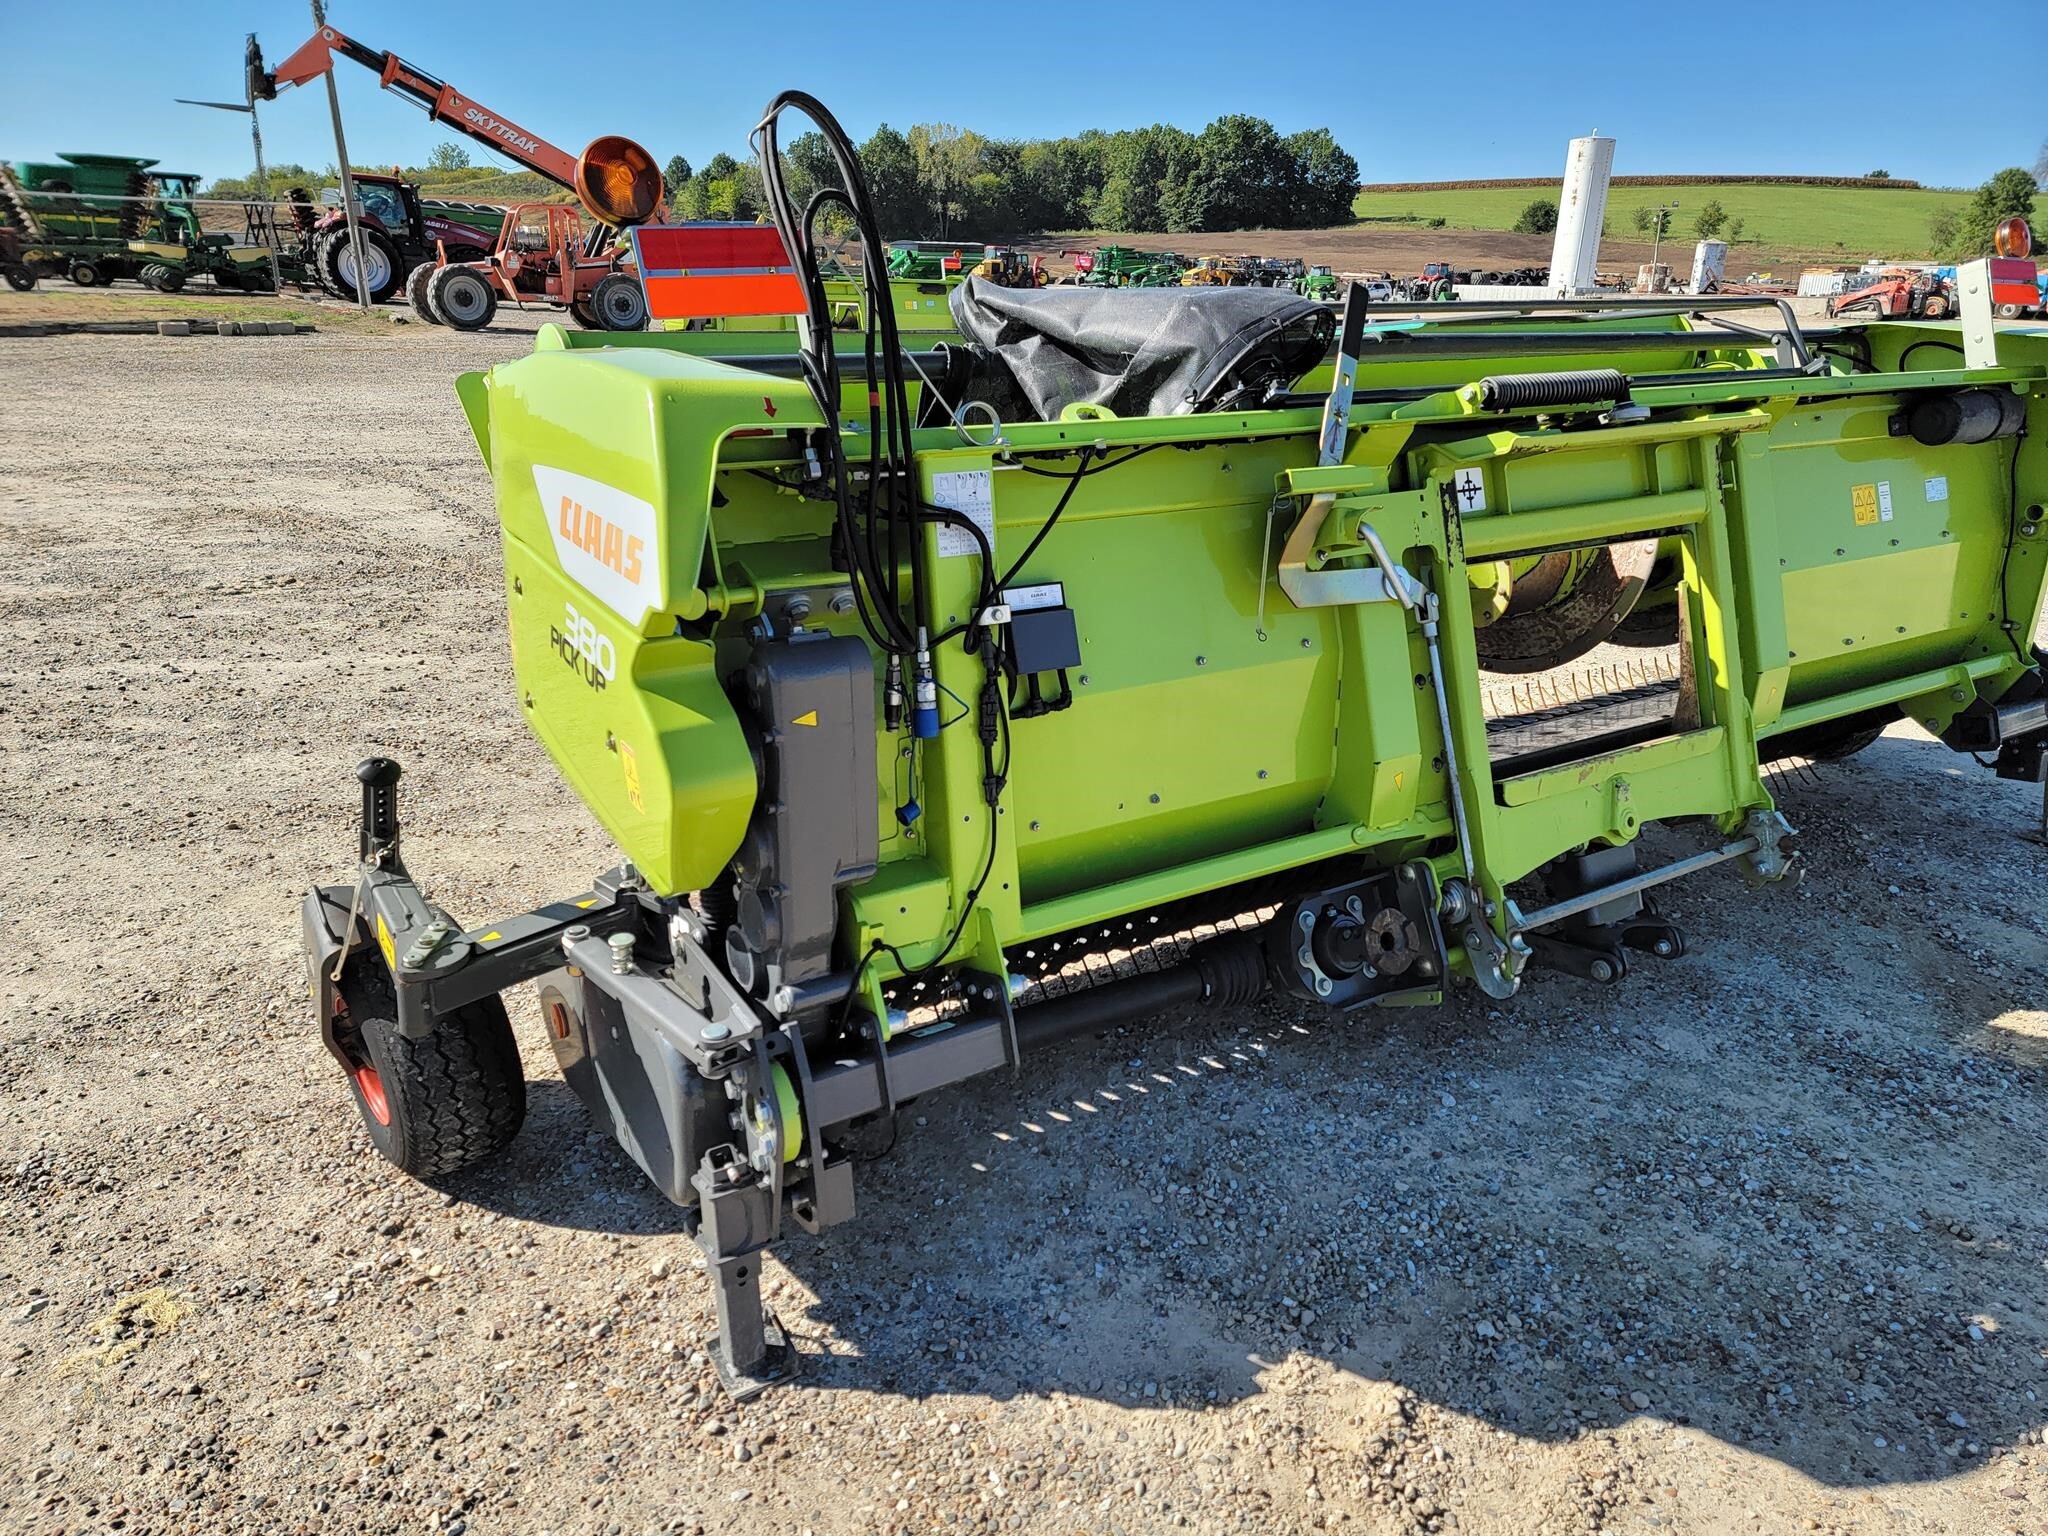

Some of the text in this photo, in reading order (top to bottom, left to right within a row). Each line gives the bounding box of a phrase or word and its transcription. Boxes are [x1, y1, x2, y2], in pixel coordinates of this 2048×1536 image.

[463, 107, 540, 155] SKYTRAK
[559, 495, 645, 586] CLAAS
[550, 623, 607, 694] PICK UP
[564, 600, 617, 683] 380
